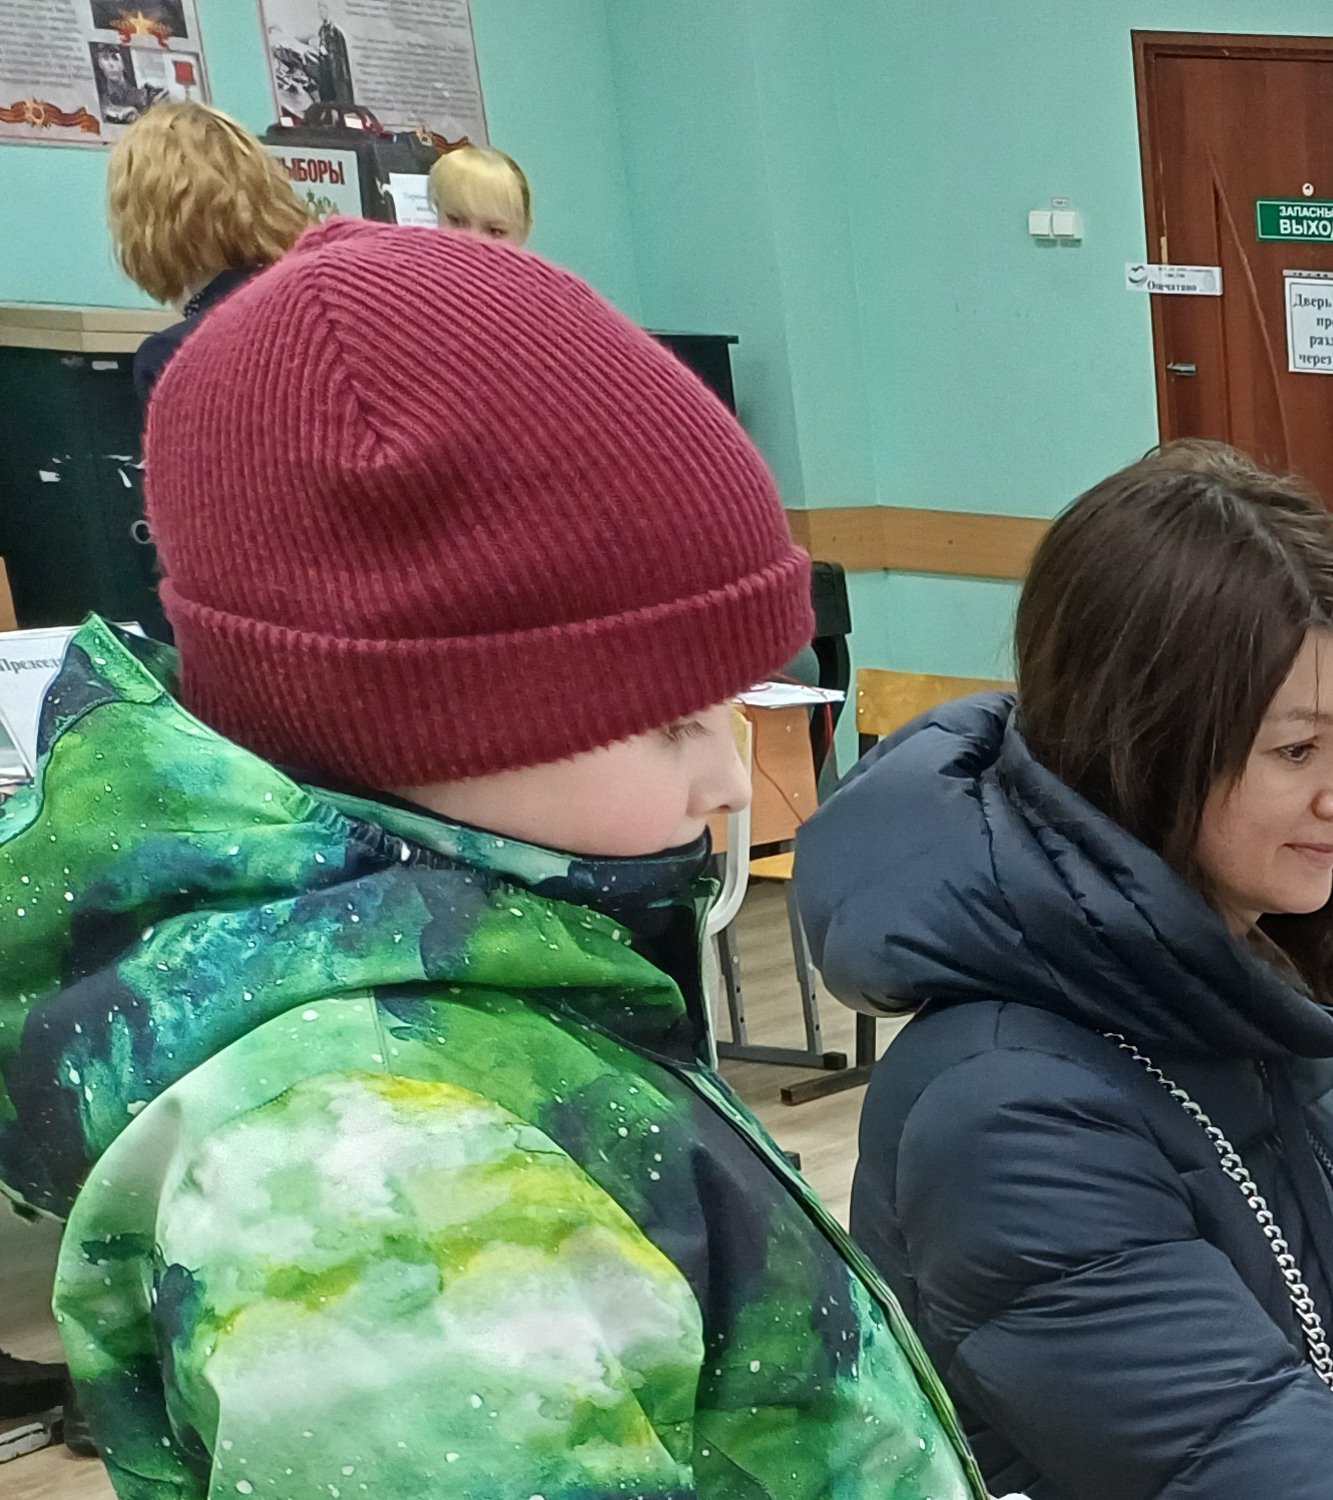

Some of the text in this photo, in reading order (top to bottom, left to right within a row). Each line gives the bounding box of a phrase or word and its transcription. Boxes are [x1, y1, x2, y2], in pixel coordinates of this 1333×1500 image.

[277, 157, 345, 185] ЫБОРЫ
[1293, 293, 1332, 310] Дверь
[1299, 354, 1332, 367] через
